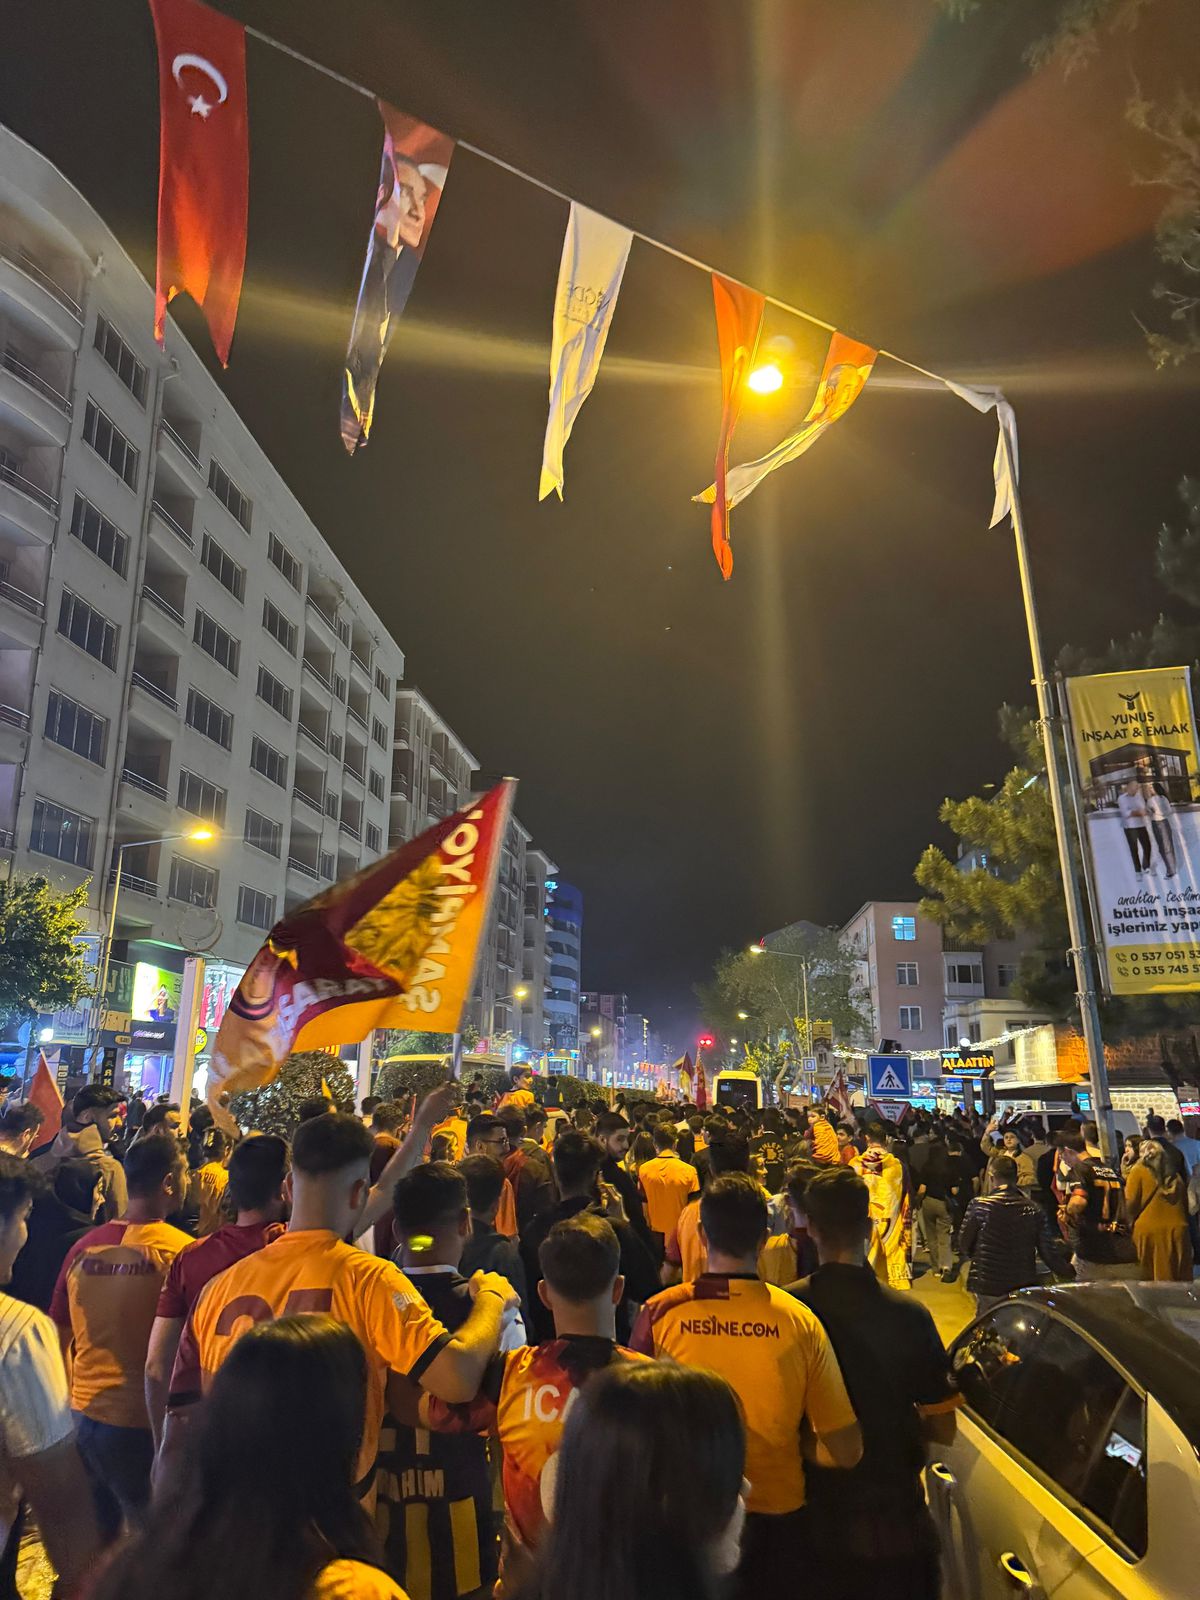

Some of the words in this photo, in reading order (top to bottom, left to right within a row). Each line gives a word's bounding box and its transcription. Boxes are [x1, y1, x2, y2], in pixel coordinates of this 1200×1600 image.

[1112, 711, 1155, 725] YUNUS
[1081, 728, 1128, 742] İNŞAAT
[1132, 727, 1142, 738] &
[1146, 722, 1190, 737] EMLAK
[1117, 889, 1161, 906] anahtar
[1113, 906, 1158, 919] bütün
[1107, 920, 1168, 937] işleriniz
[1142, 951, 1161, 961] 537
[1165, 950, 1185, 960] 051
[1144, 965, 1165, 975] 535
[1168, 964, 1189, 974] 745
[942, 1054, 994, 1070] ALAATTİN
